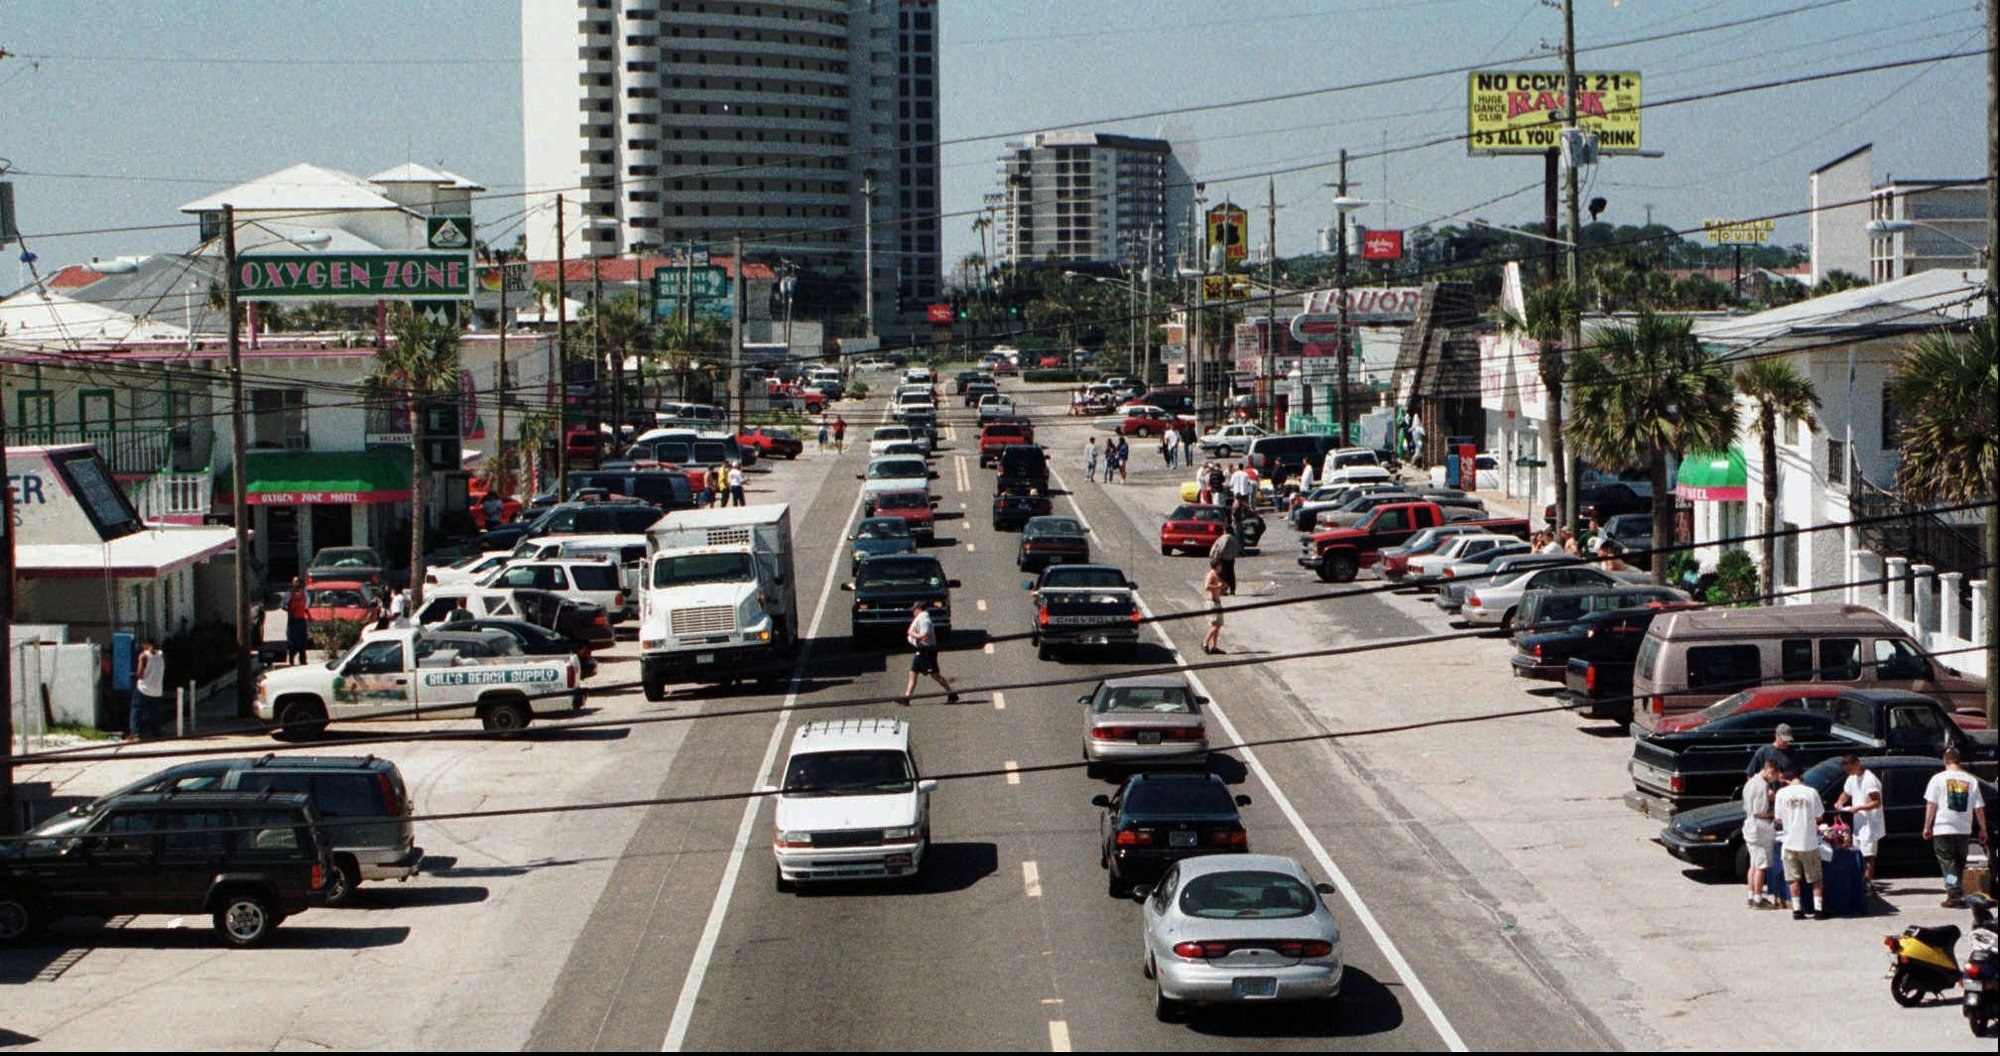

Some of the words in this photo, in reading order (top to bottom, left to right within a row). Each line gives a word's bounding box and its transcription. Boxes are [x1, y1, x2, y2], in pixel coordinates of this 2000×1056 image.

[1478, 75, 1508, 90] NO
[1516, 75, 1587, 90] COVR
[1596, 75, 1634, 90] 21+
[1478, 95, 1502, 103] HUGE
[1474, 104, 1506, 112] DANCE
[1478, 113, 1502, 121] CLUB
[1475, 130, 1494, 144] $5
[1498, 131, 1522, 144] ALL
[1527, 131, 1554, 144] YOU
[1709, 231, 1766, 241] HOUSE
[241, 261, 370, 289] OXYGEN
[383, 261, 467, 289] ZONE
[301, 494, 323, 503] ZONE
[330, 493, 358, 502] MOTEL
[429, 674, 463, 685] BILL'S
[468, 672, 505, 683] BEACH
[510, 669, 554, 681] SUPPLY
